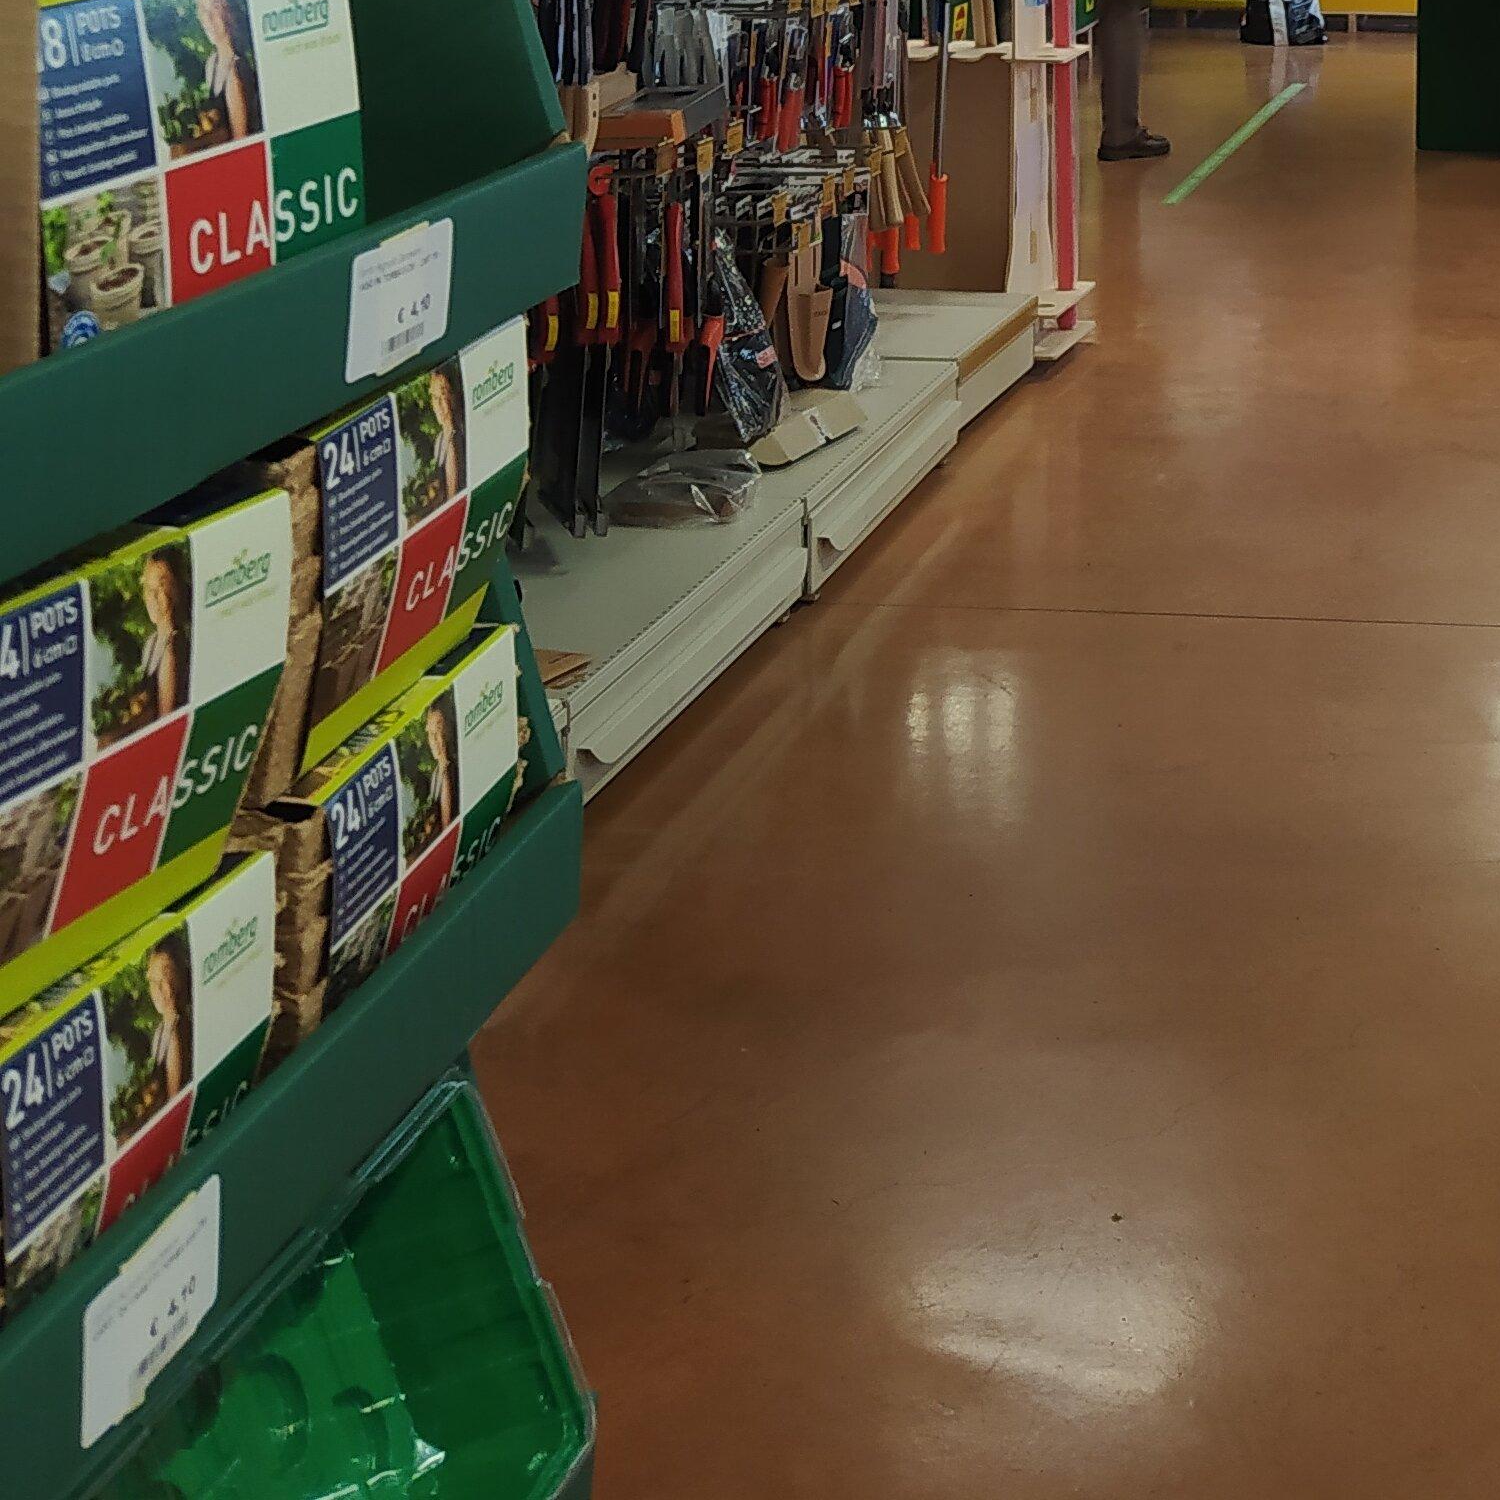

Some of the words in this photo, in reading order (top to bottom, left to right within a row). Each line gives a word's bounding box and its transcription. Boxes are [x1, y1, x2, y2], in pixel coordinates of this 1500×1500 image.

[74, 5, 122, 36] POTS
[188, 166, 360, 276] CLASSIC
[324, 431, 354, 491] 24
[359, 407, 391, 444] POTS
[405, 502, 512, 612] CLASSIC
[30, 597, 79, 639] POTS
[93, 723, 257, 857] CLASSIC
[331, 789, 360, 850] 24
[363, 755, 392, 797] POTS
[2, 1052, 44, 1131] 24
[51, 1009, 94, 1061] POTS
